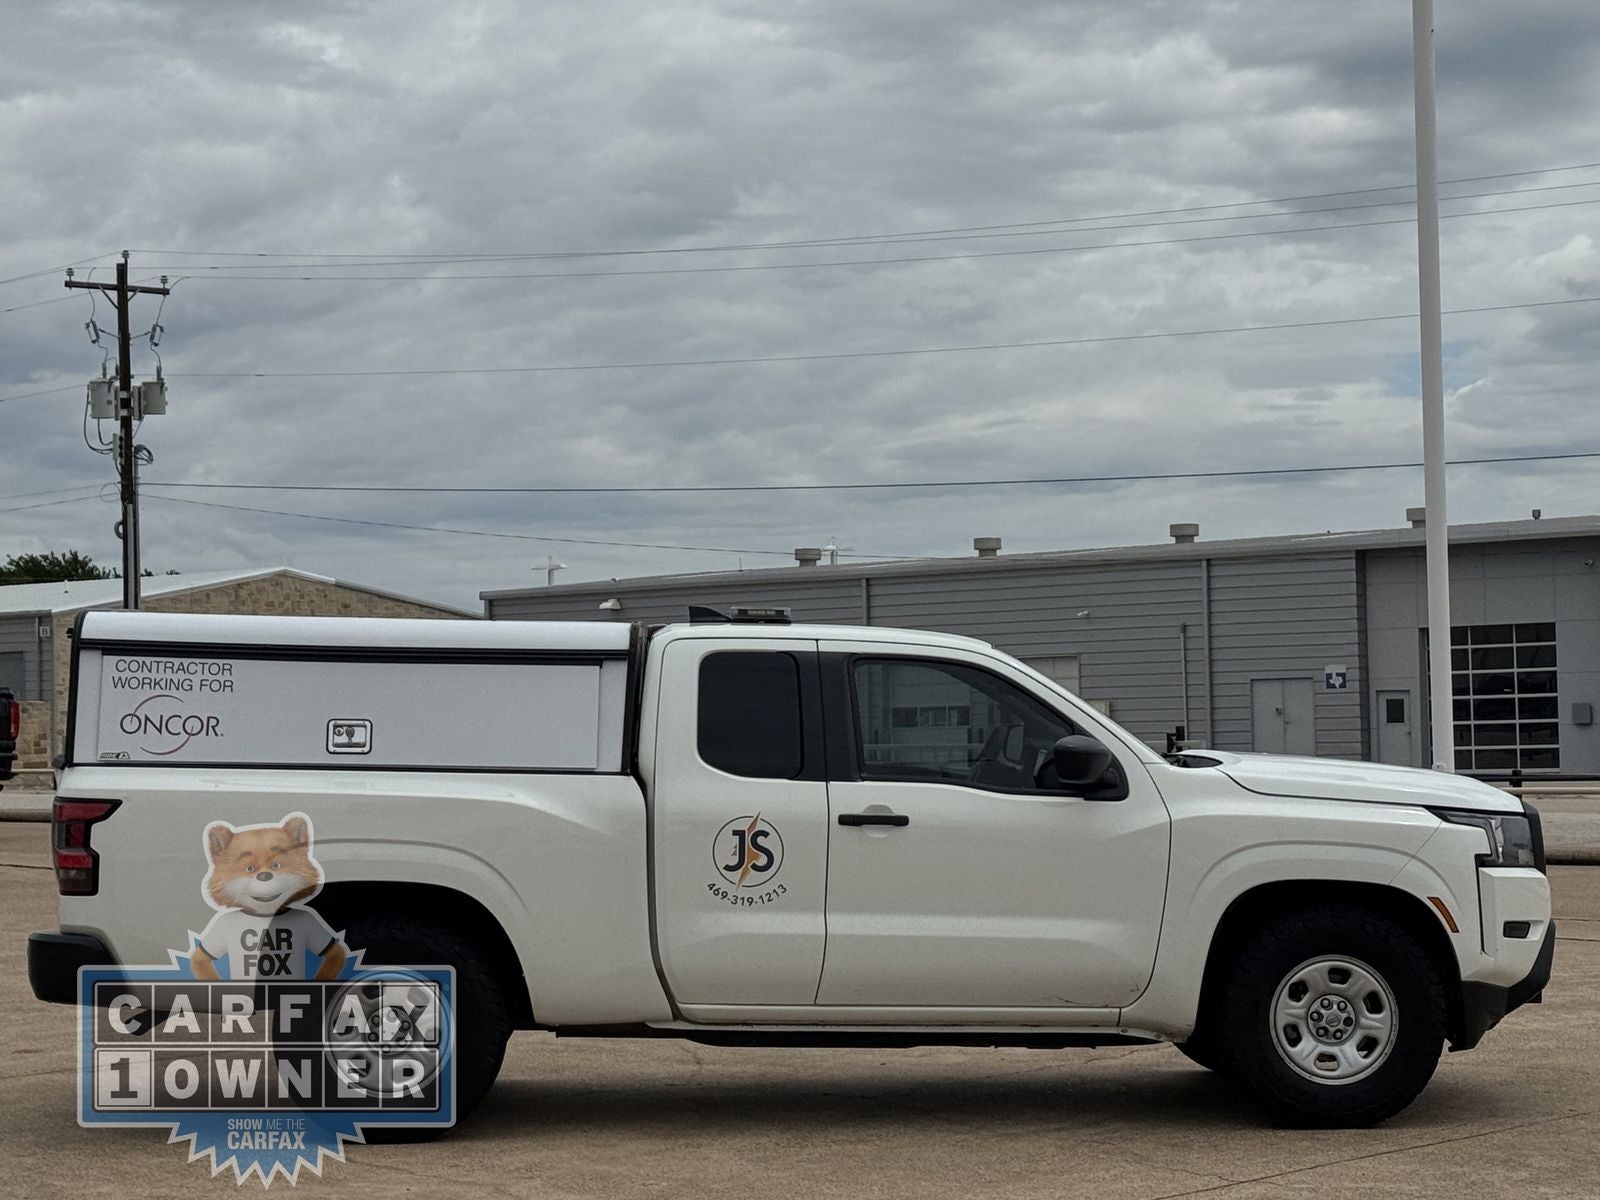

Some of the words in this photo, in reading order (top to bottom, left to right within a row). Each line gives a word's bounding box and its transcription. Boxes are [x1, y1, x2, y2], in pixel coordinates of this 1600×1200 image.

[115, 659, 233, 676] CONTRACTOR
[112, 676, 193, 692] WORKING
[200, 678, 234, 693] FOR
[722, 830, 775, 872] JS
[707, 883, 788, 907] 469-319-1213
